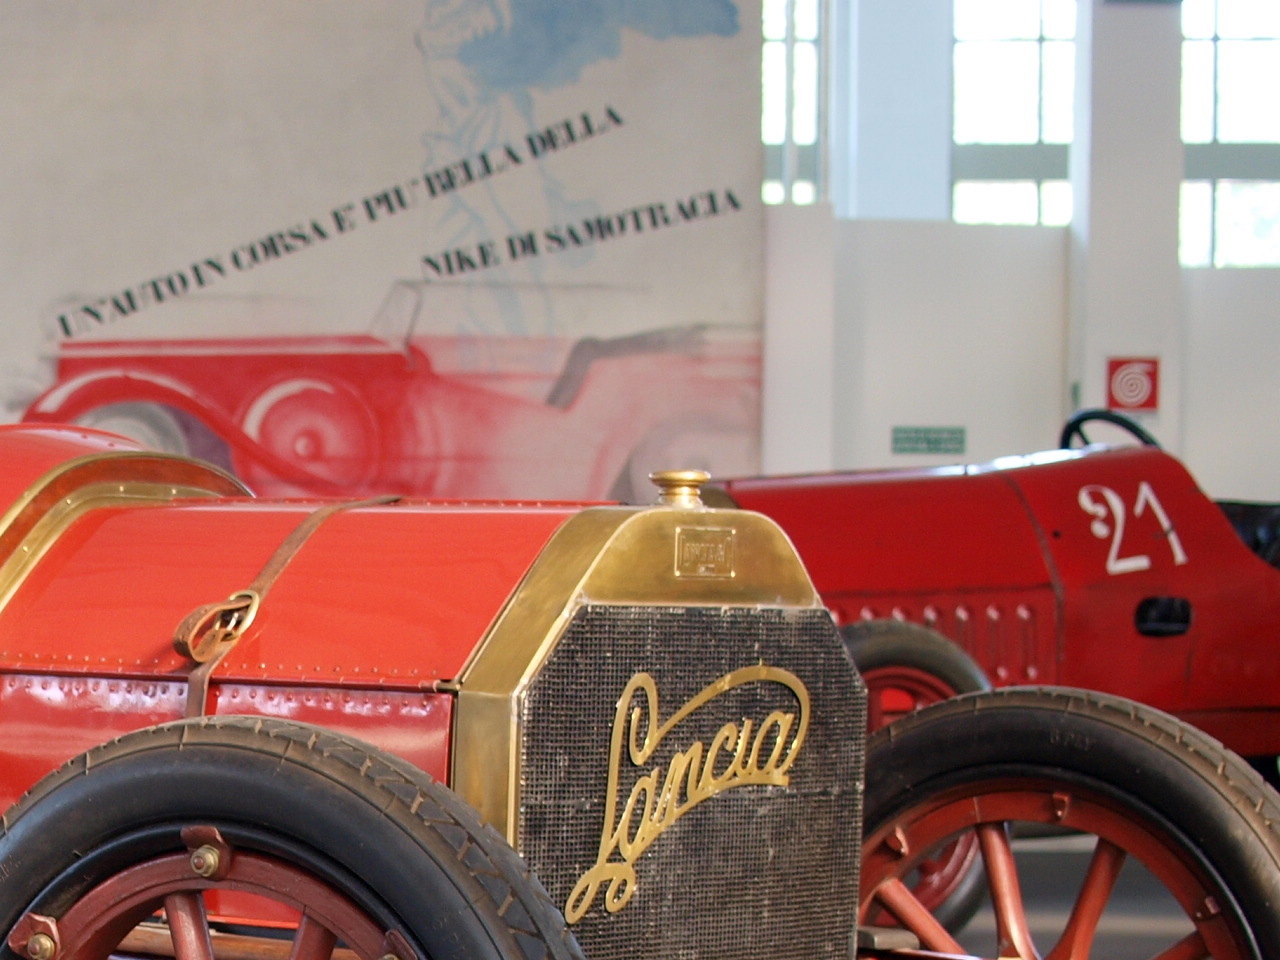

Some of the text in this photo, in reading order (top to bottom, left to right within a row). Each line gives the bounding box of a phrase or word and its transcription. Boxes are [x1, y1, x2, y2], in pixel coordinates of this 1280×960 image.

[57, 268, 189, 338] UN'AUTO
[190, 255, 226, 288] IN
[230, 219, 329, 272] CORSA
[362, 178, 420, 223] PIU'
[423, 143, 525, 200] BELLA
[525, 102, 625, 160] DELLA
[423, 188, 742, 279] NIKE DI SAMOTRACIA
[1077, 481, 1188, 576] 21
[564, 664, 811, 925] Lancia
